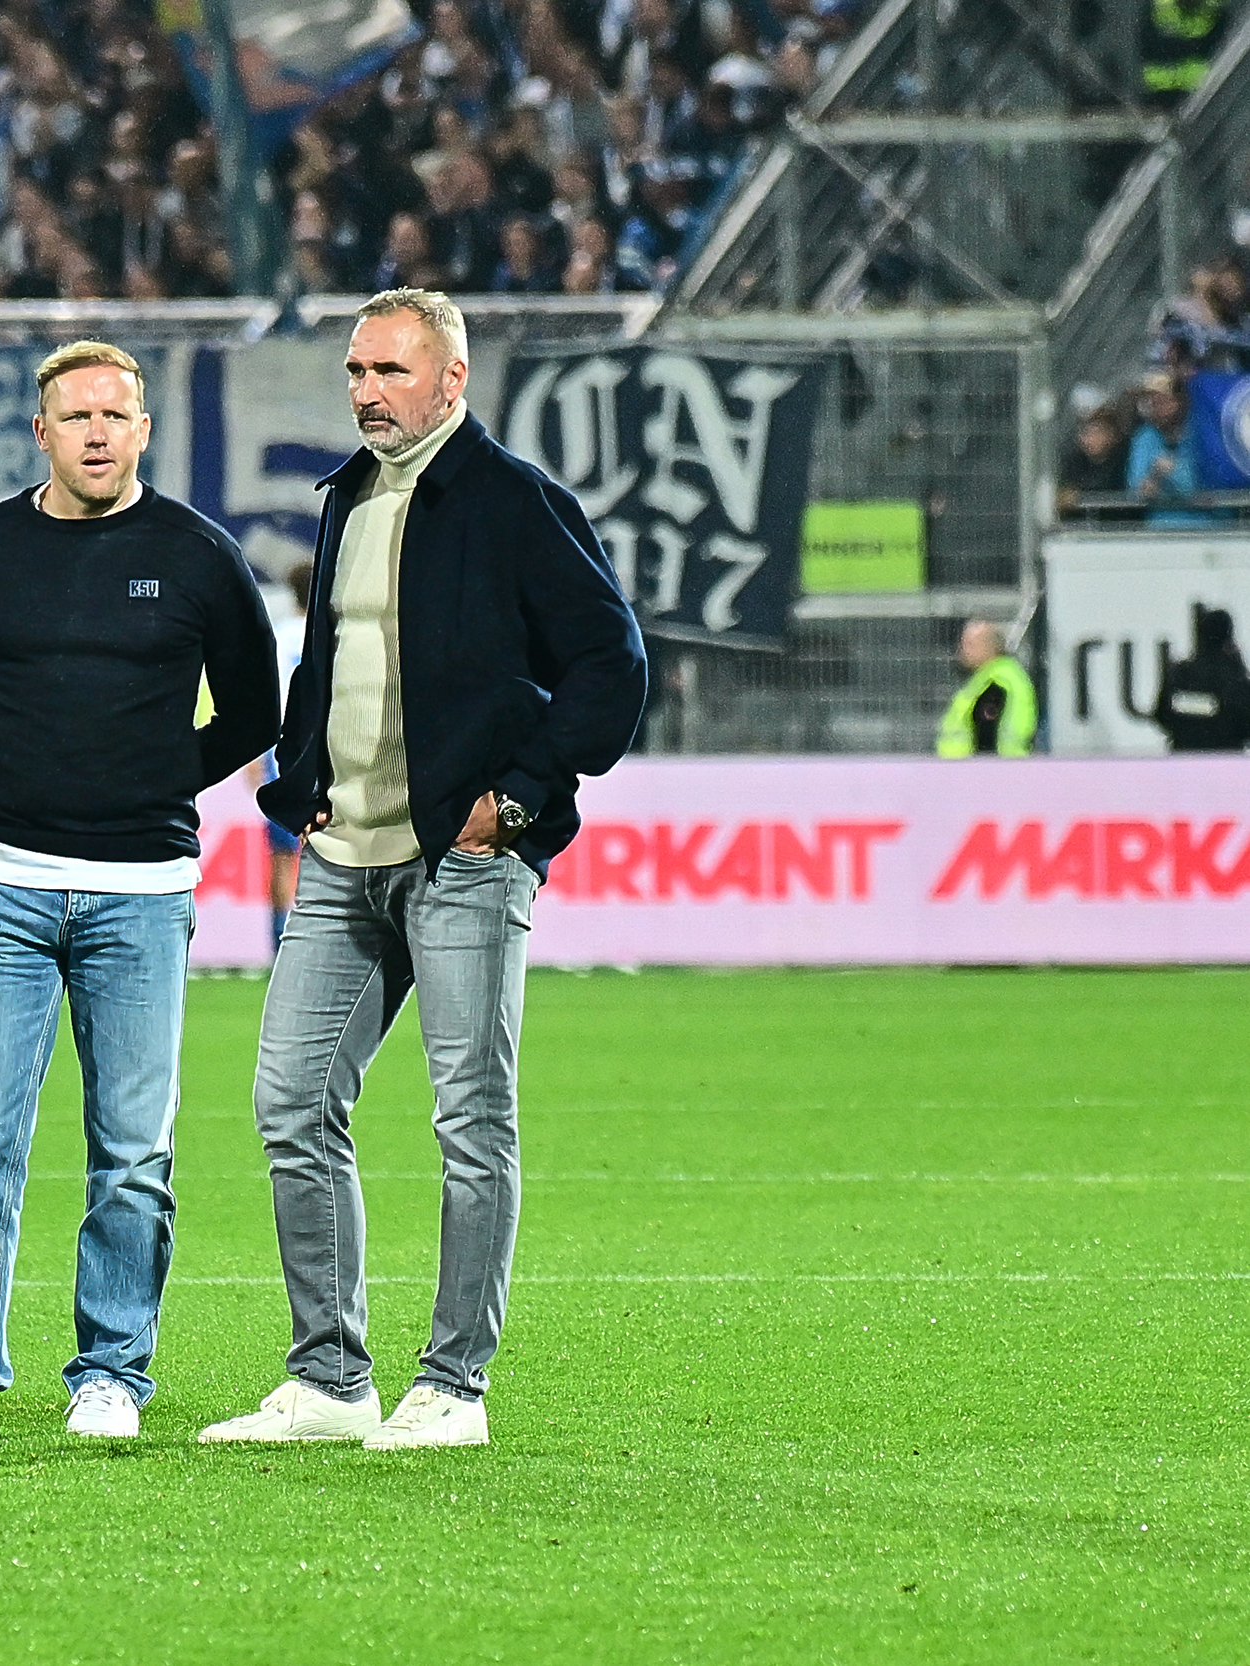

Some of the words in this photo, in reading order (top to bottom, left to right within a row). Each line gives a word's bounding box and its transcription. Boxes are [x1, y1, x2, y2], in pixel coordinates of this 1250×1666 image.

[130, 581, 157, 597] KSV
[542, 820, 906, 901] ARKANT
[934, 820, 1250, 899] MARK
